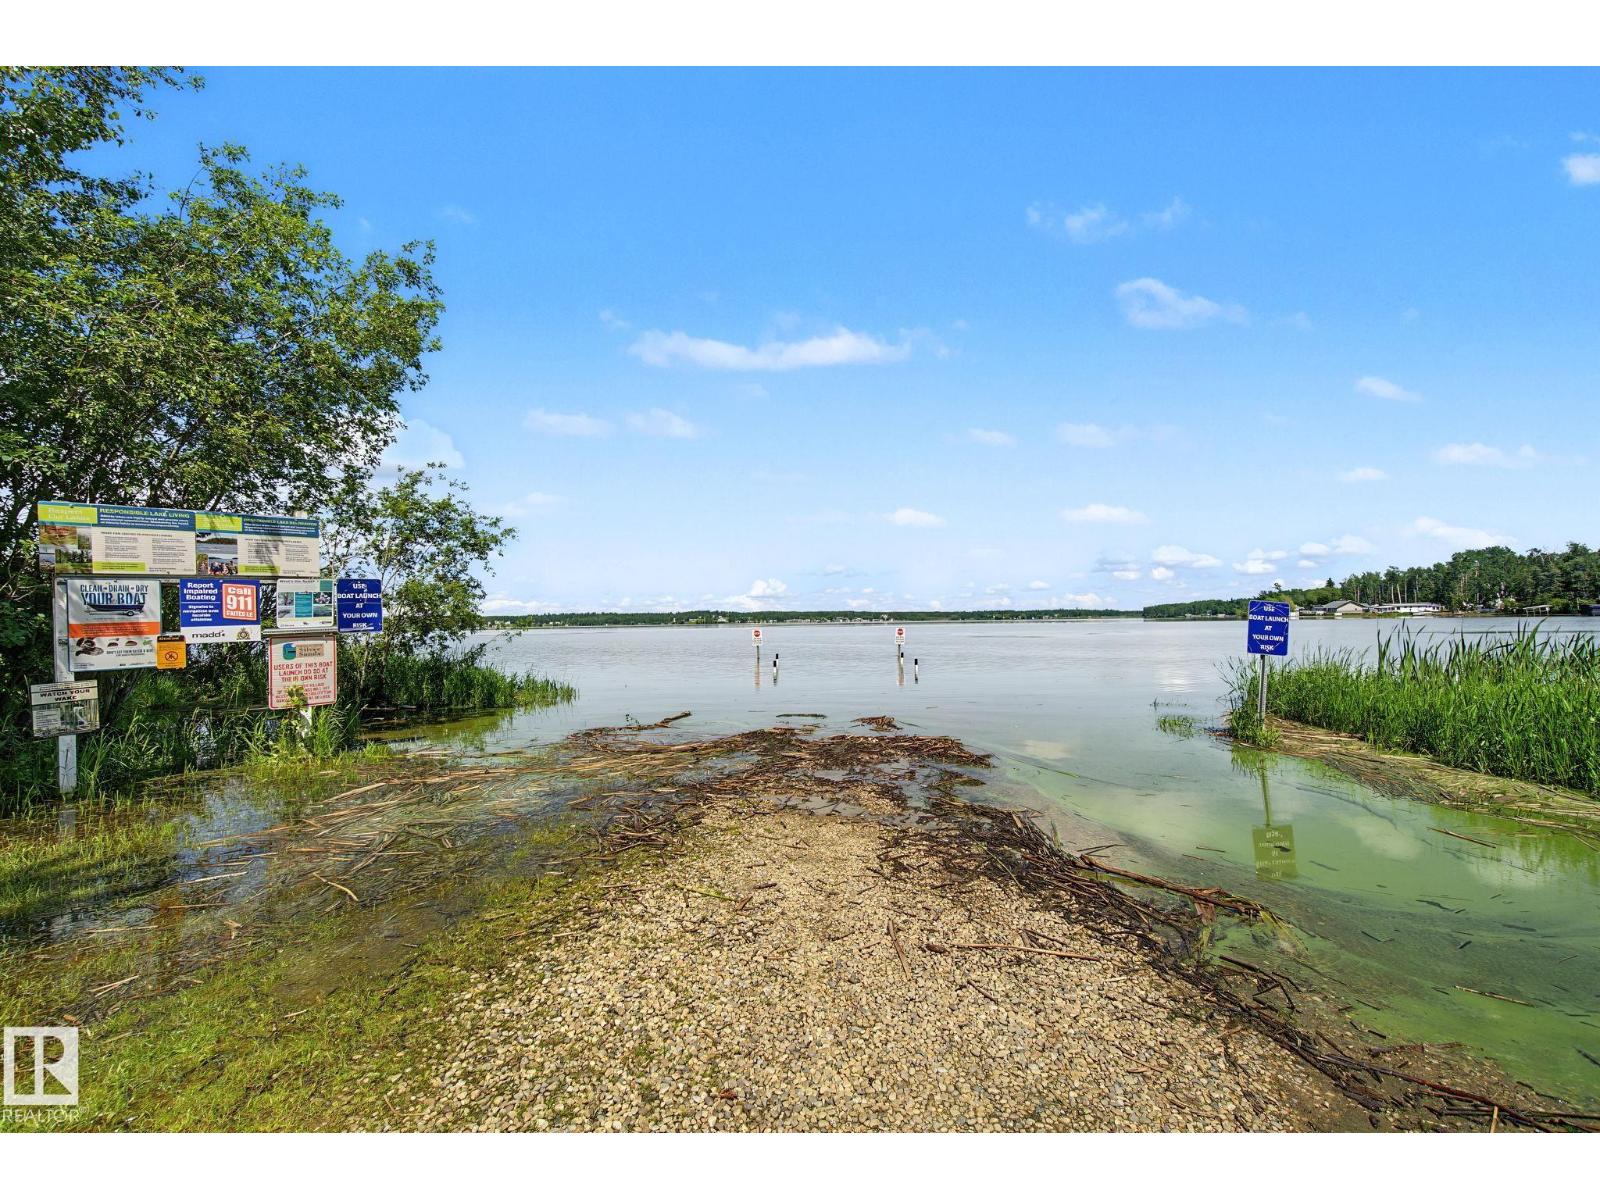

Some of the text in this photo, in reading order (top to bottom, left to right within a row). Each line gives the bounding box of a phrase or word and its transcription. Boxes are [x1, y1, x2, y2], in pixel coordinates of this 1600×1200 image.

[99, 508, 148, 516] RESPONSIBLE
[80, 584, 149, 592] CLEAN DRAIN DRY
[227, 586, 252, 595] Call
[81, 592, 148, 605] YOUR BOAT
[226, 594, 253, 611] 911
[192, 631, 220, 639] madd
[40, 690, 67, 698] WATCH
